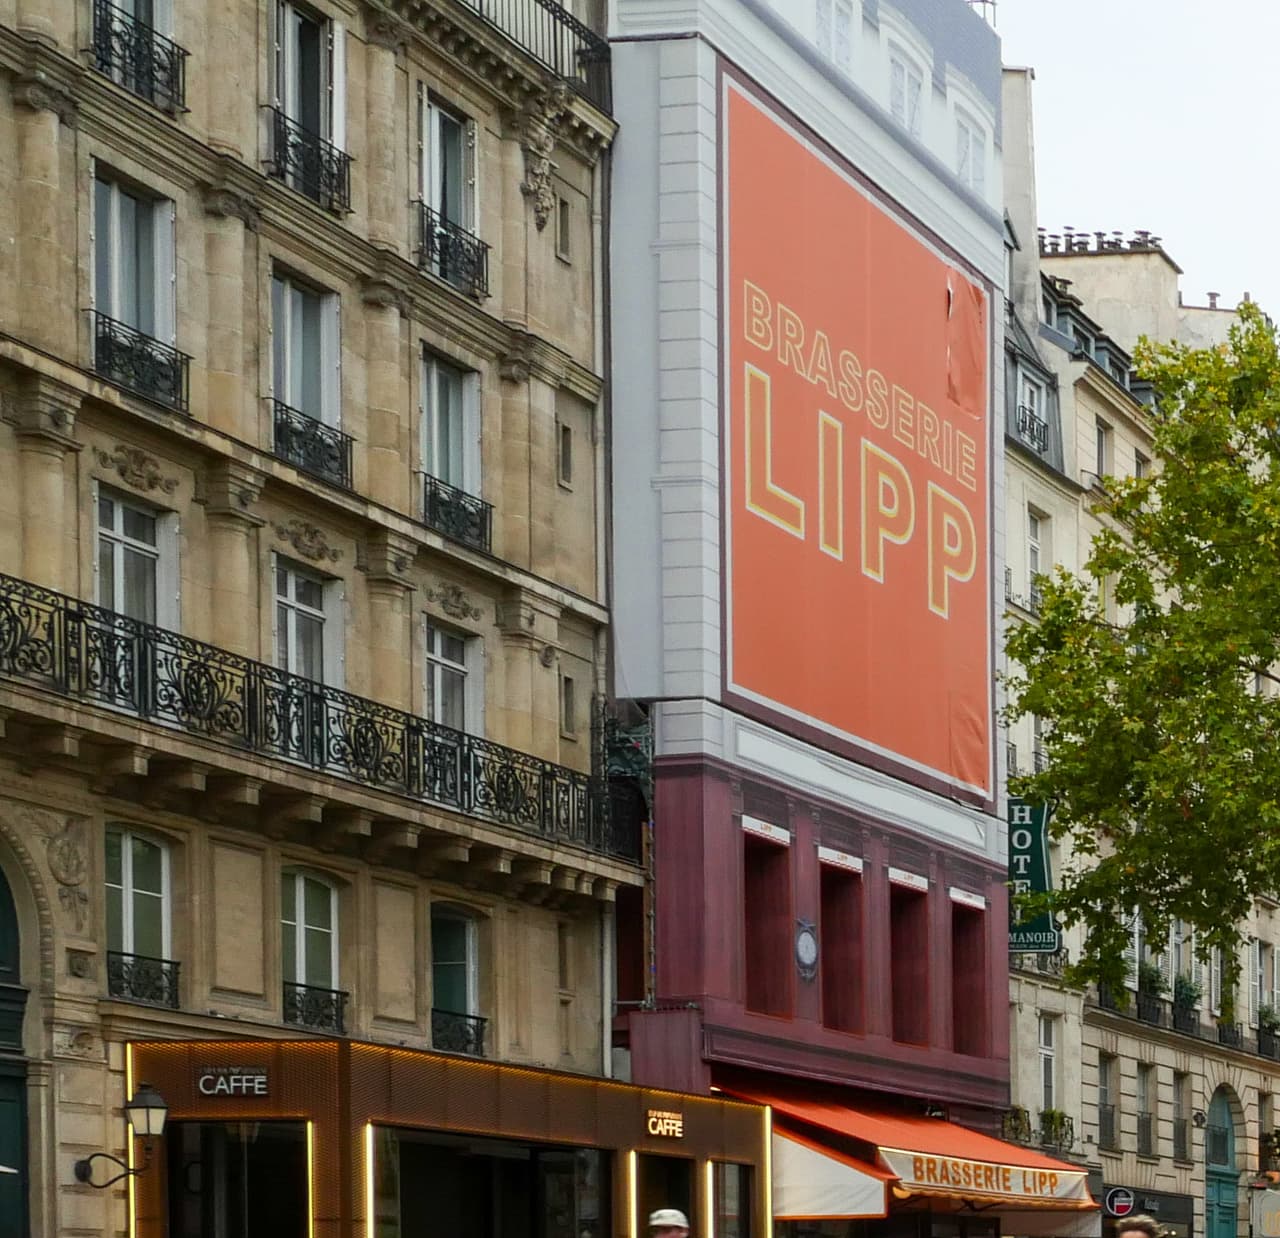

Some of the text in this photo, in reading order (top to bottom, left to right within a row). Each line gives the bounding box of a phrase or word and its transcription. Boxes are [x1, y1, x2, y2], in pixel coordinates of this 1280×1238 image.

[743, 279, 978, 492] BRASSERIE
[744, 361, 978, 620] LIPP
[1008, 931, 1055, 943] MANOIR
[912, 1156, 1059, 1194] BRASSERIE LIPP
